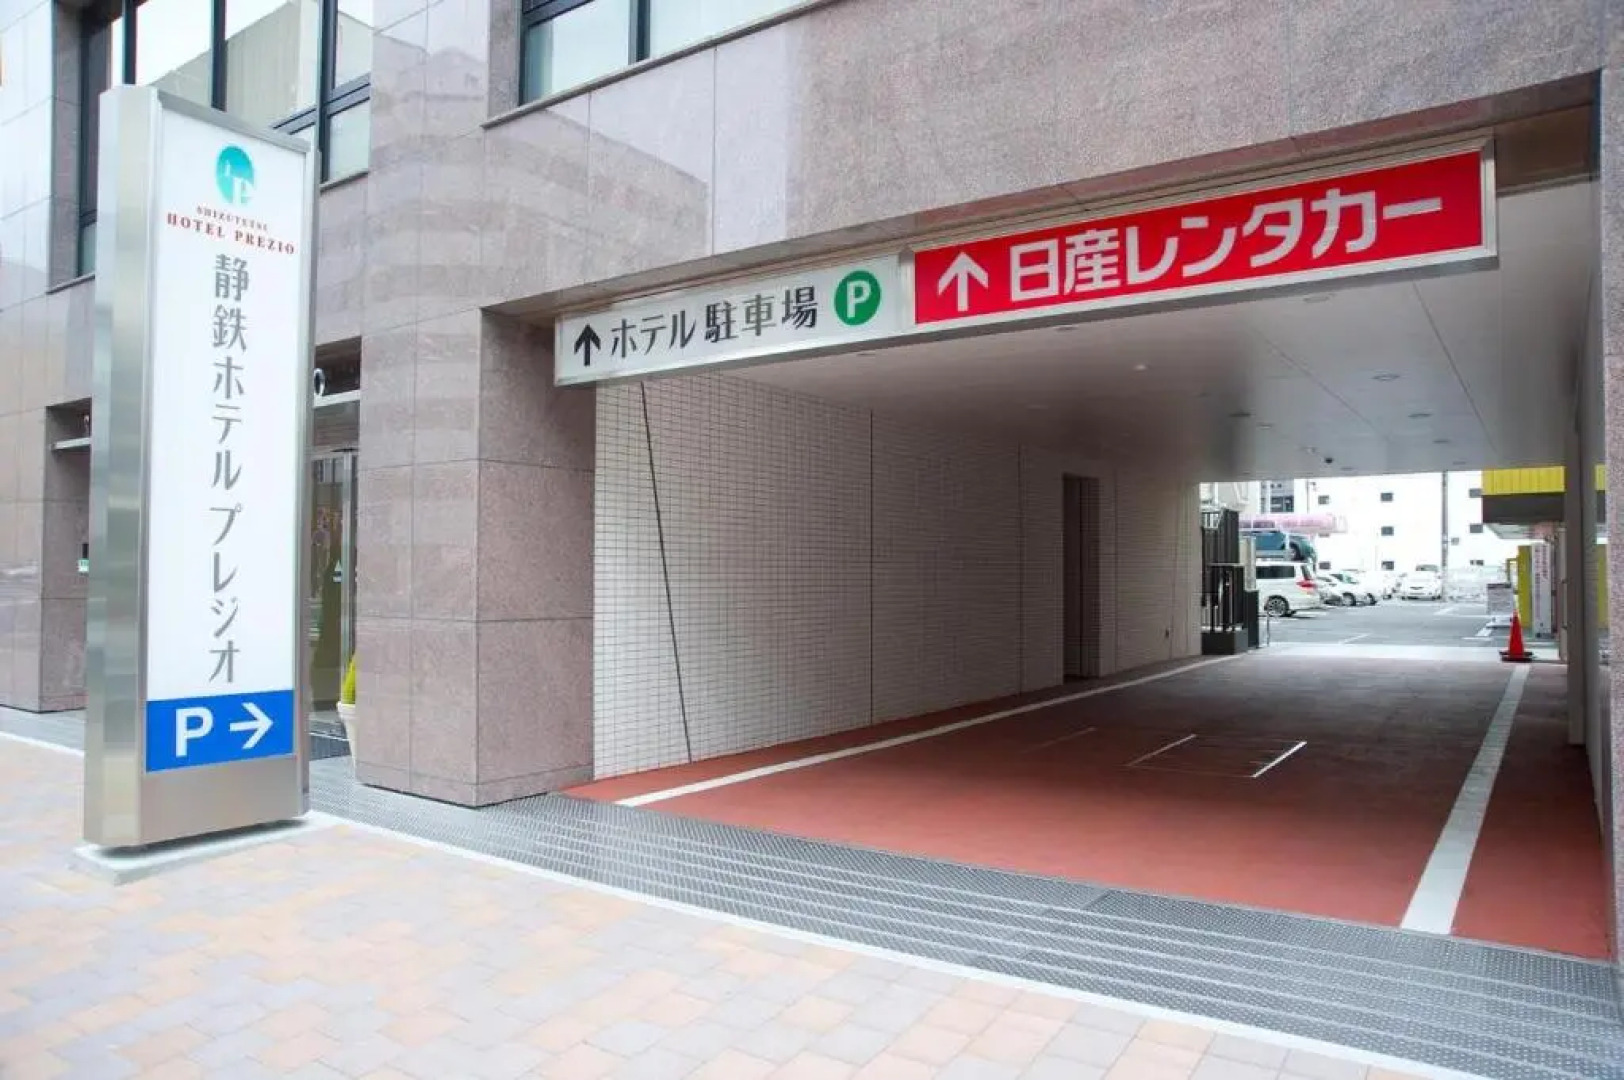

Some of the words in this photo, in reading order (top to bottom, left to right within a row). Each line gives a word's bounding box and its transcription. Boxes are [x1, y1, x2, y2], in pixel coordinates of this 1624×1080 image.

[167, 212, 226, 238] HOTEL
[234, 229, 295, 255] PREZIO
[1009, 188, 1442, 302] 日産レンタカー
[209, 253, 249, 683] 静鉄ホテルプレジオ
[175, 707, 214, 758] P
